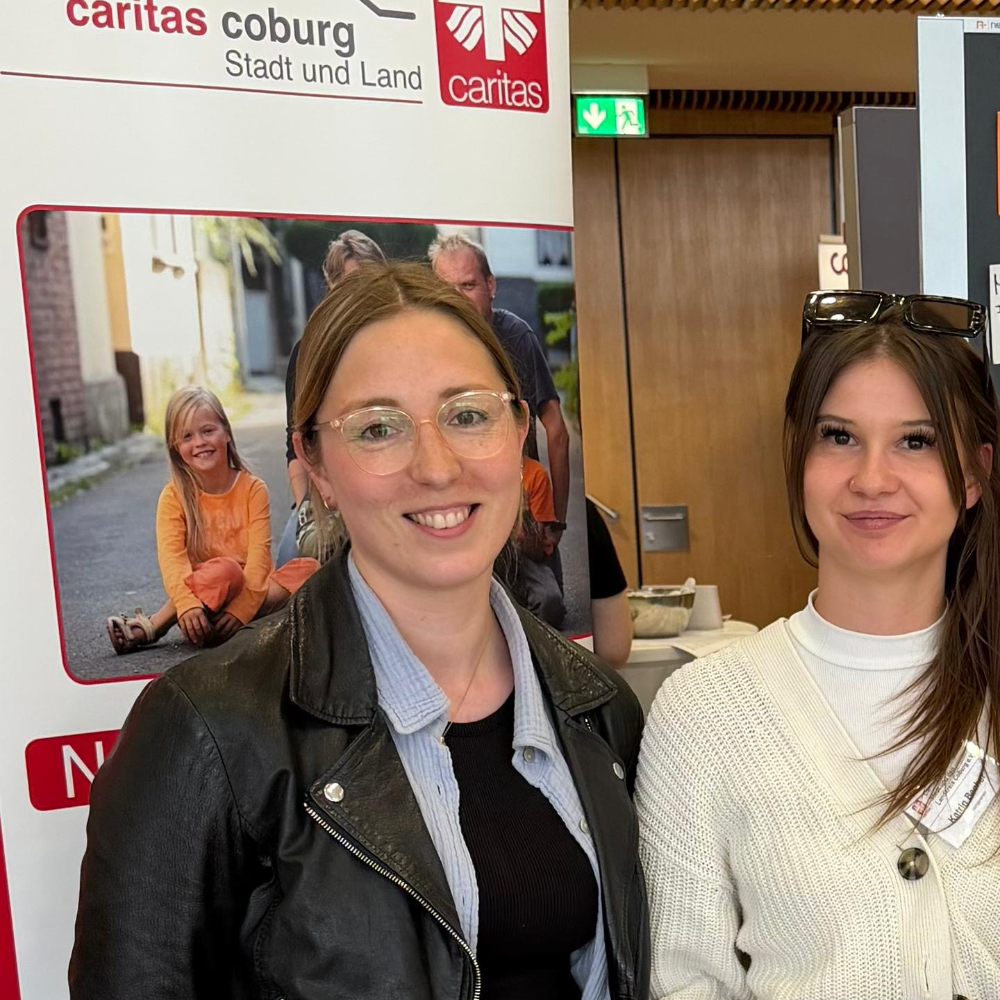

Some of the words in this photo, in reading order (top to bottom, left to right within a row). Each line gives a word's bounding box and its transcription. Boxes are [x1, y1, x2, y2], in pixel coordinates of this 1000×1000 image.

[66, 0, 208, 36] caritas
[222, 7, 356, 57] coburg
[225, 50, 293, 83] Stadt
[302, 58, 351, 86] und
[360, 61, 424, 91] Land
[448, 70, 544, 110] caritas
